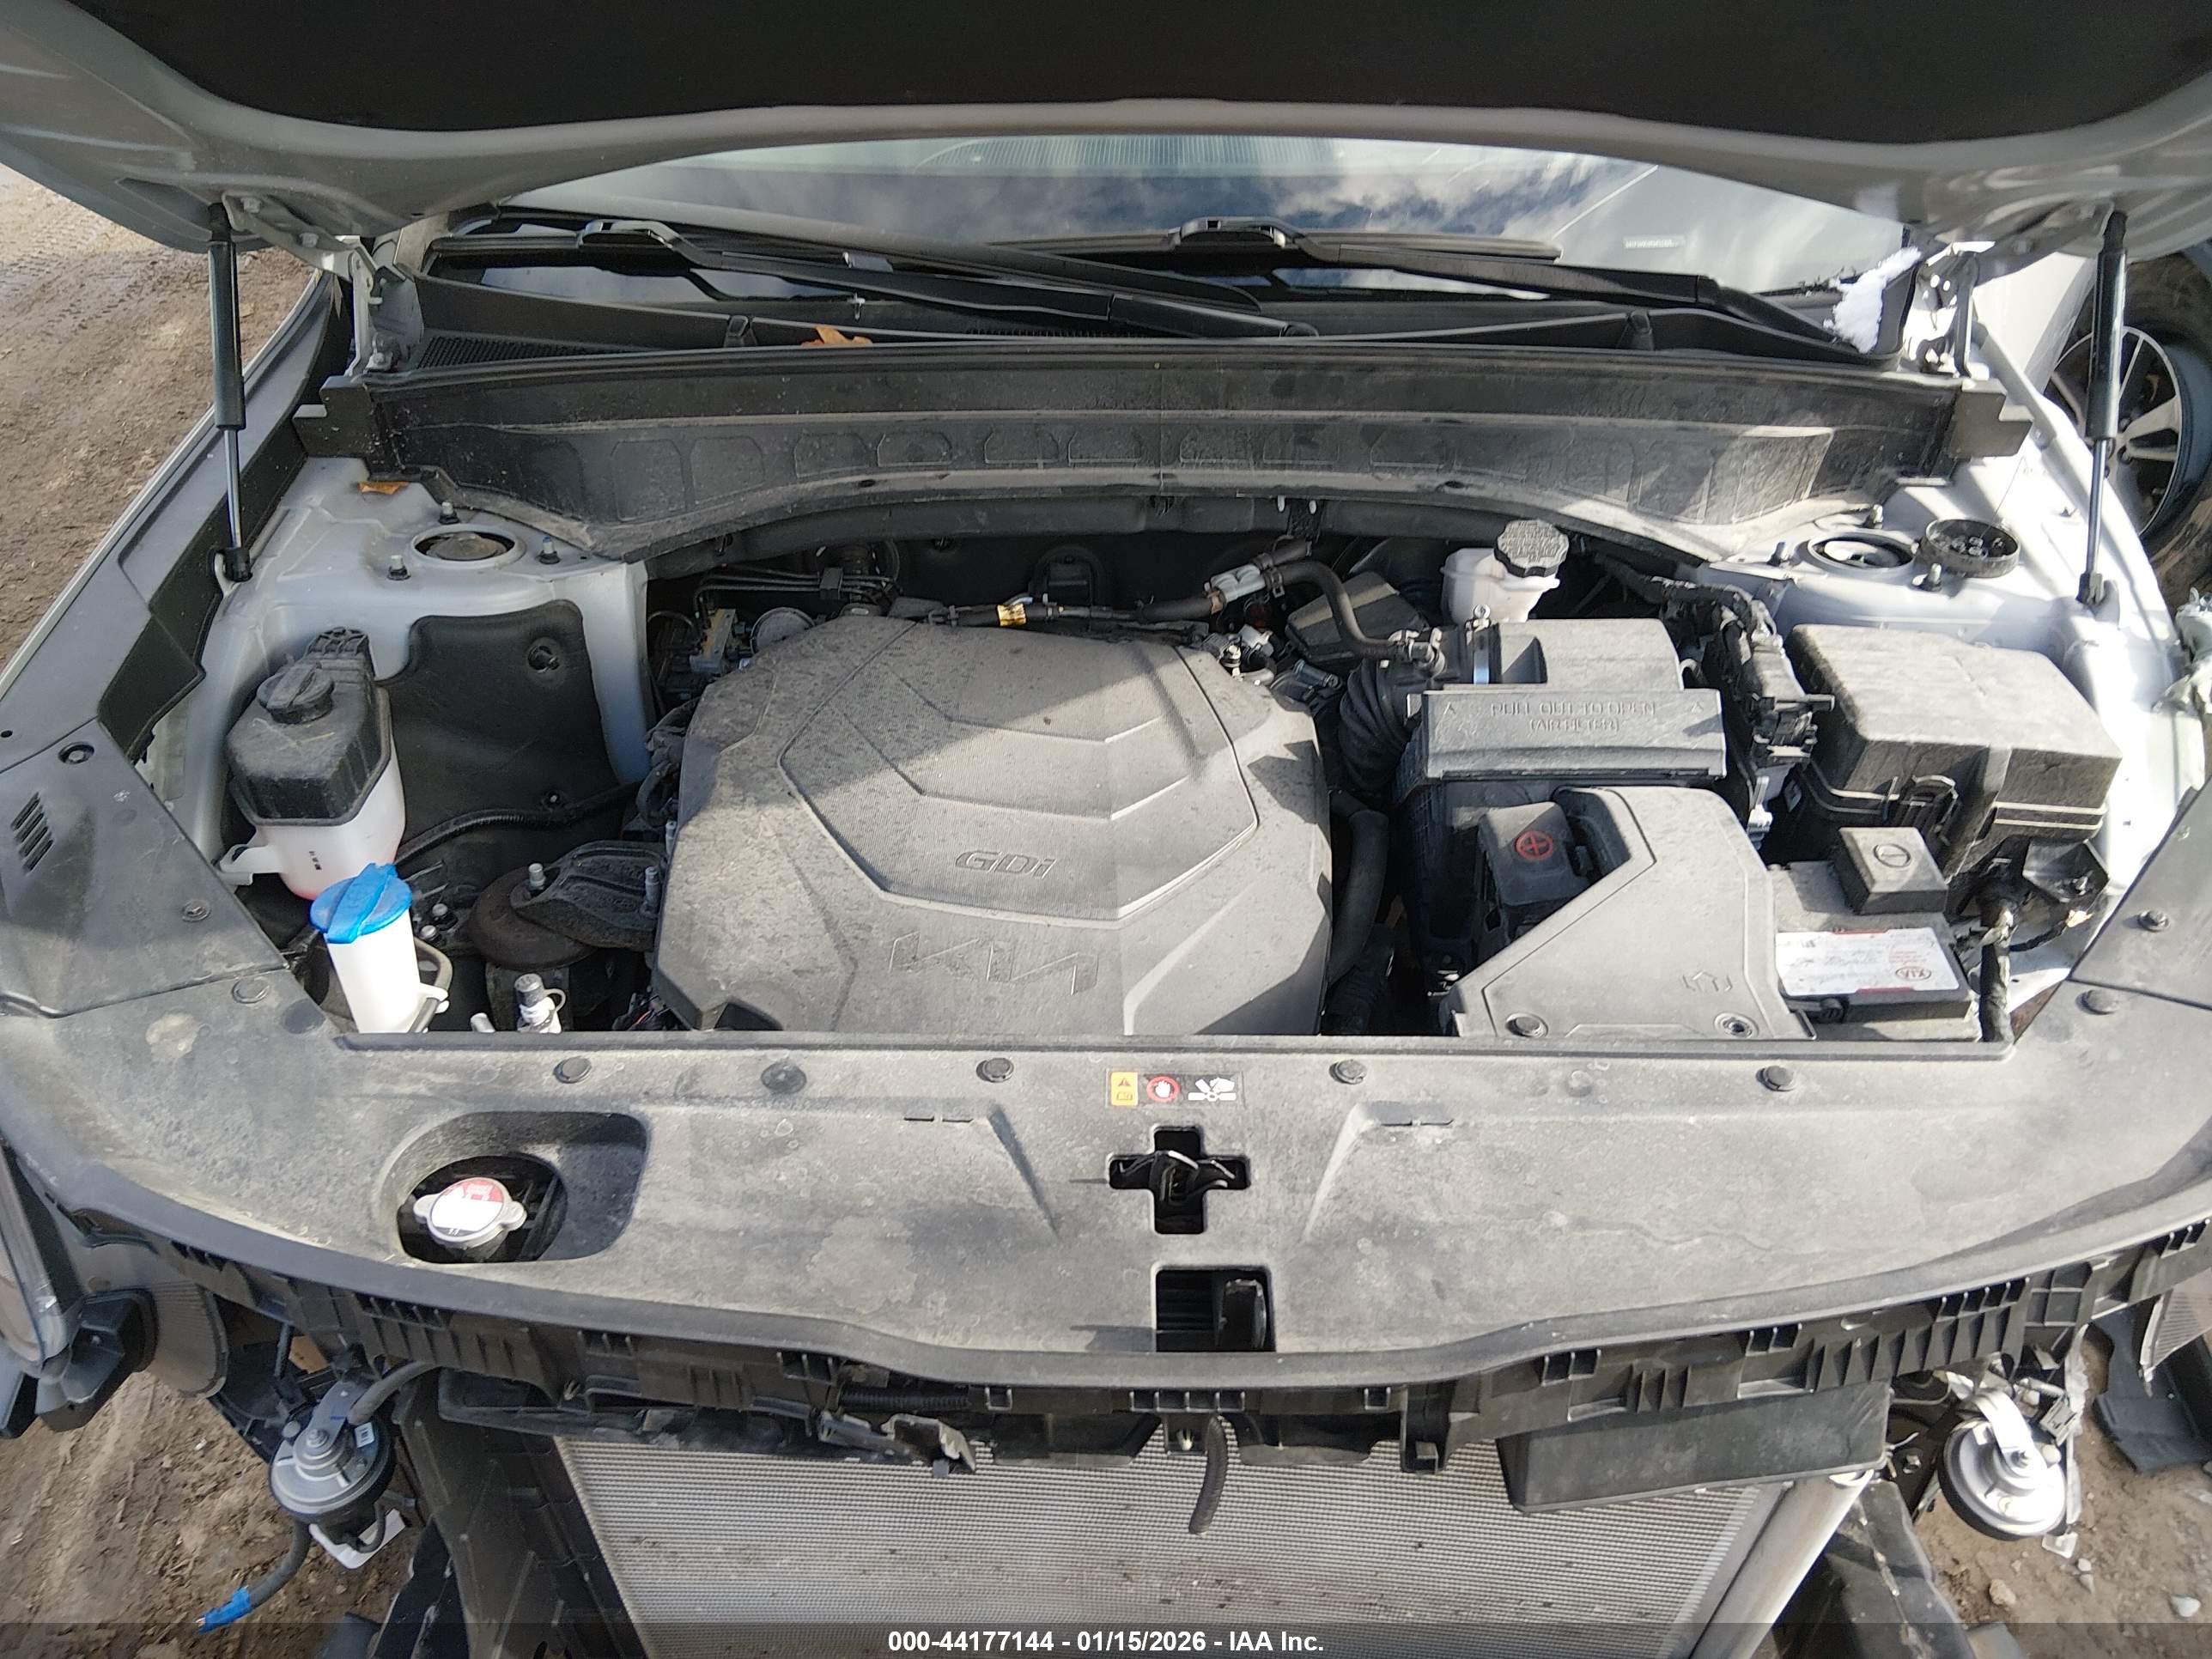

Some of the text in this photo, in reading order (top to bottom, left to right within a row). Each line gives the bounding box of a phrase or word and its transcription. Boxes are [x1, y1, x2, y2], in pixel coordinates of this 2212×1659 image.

[1490, 700, 1656, 715] PULL OUT TO OPEN
